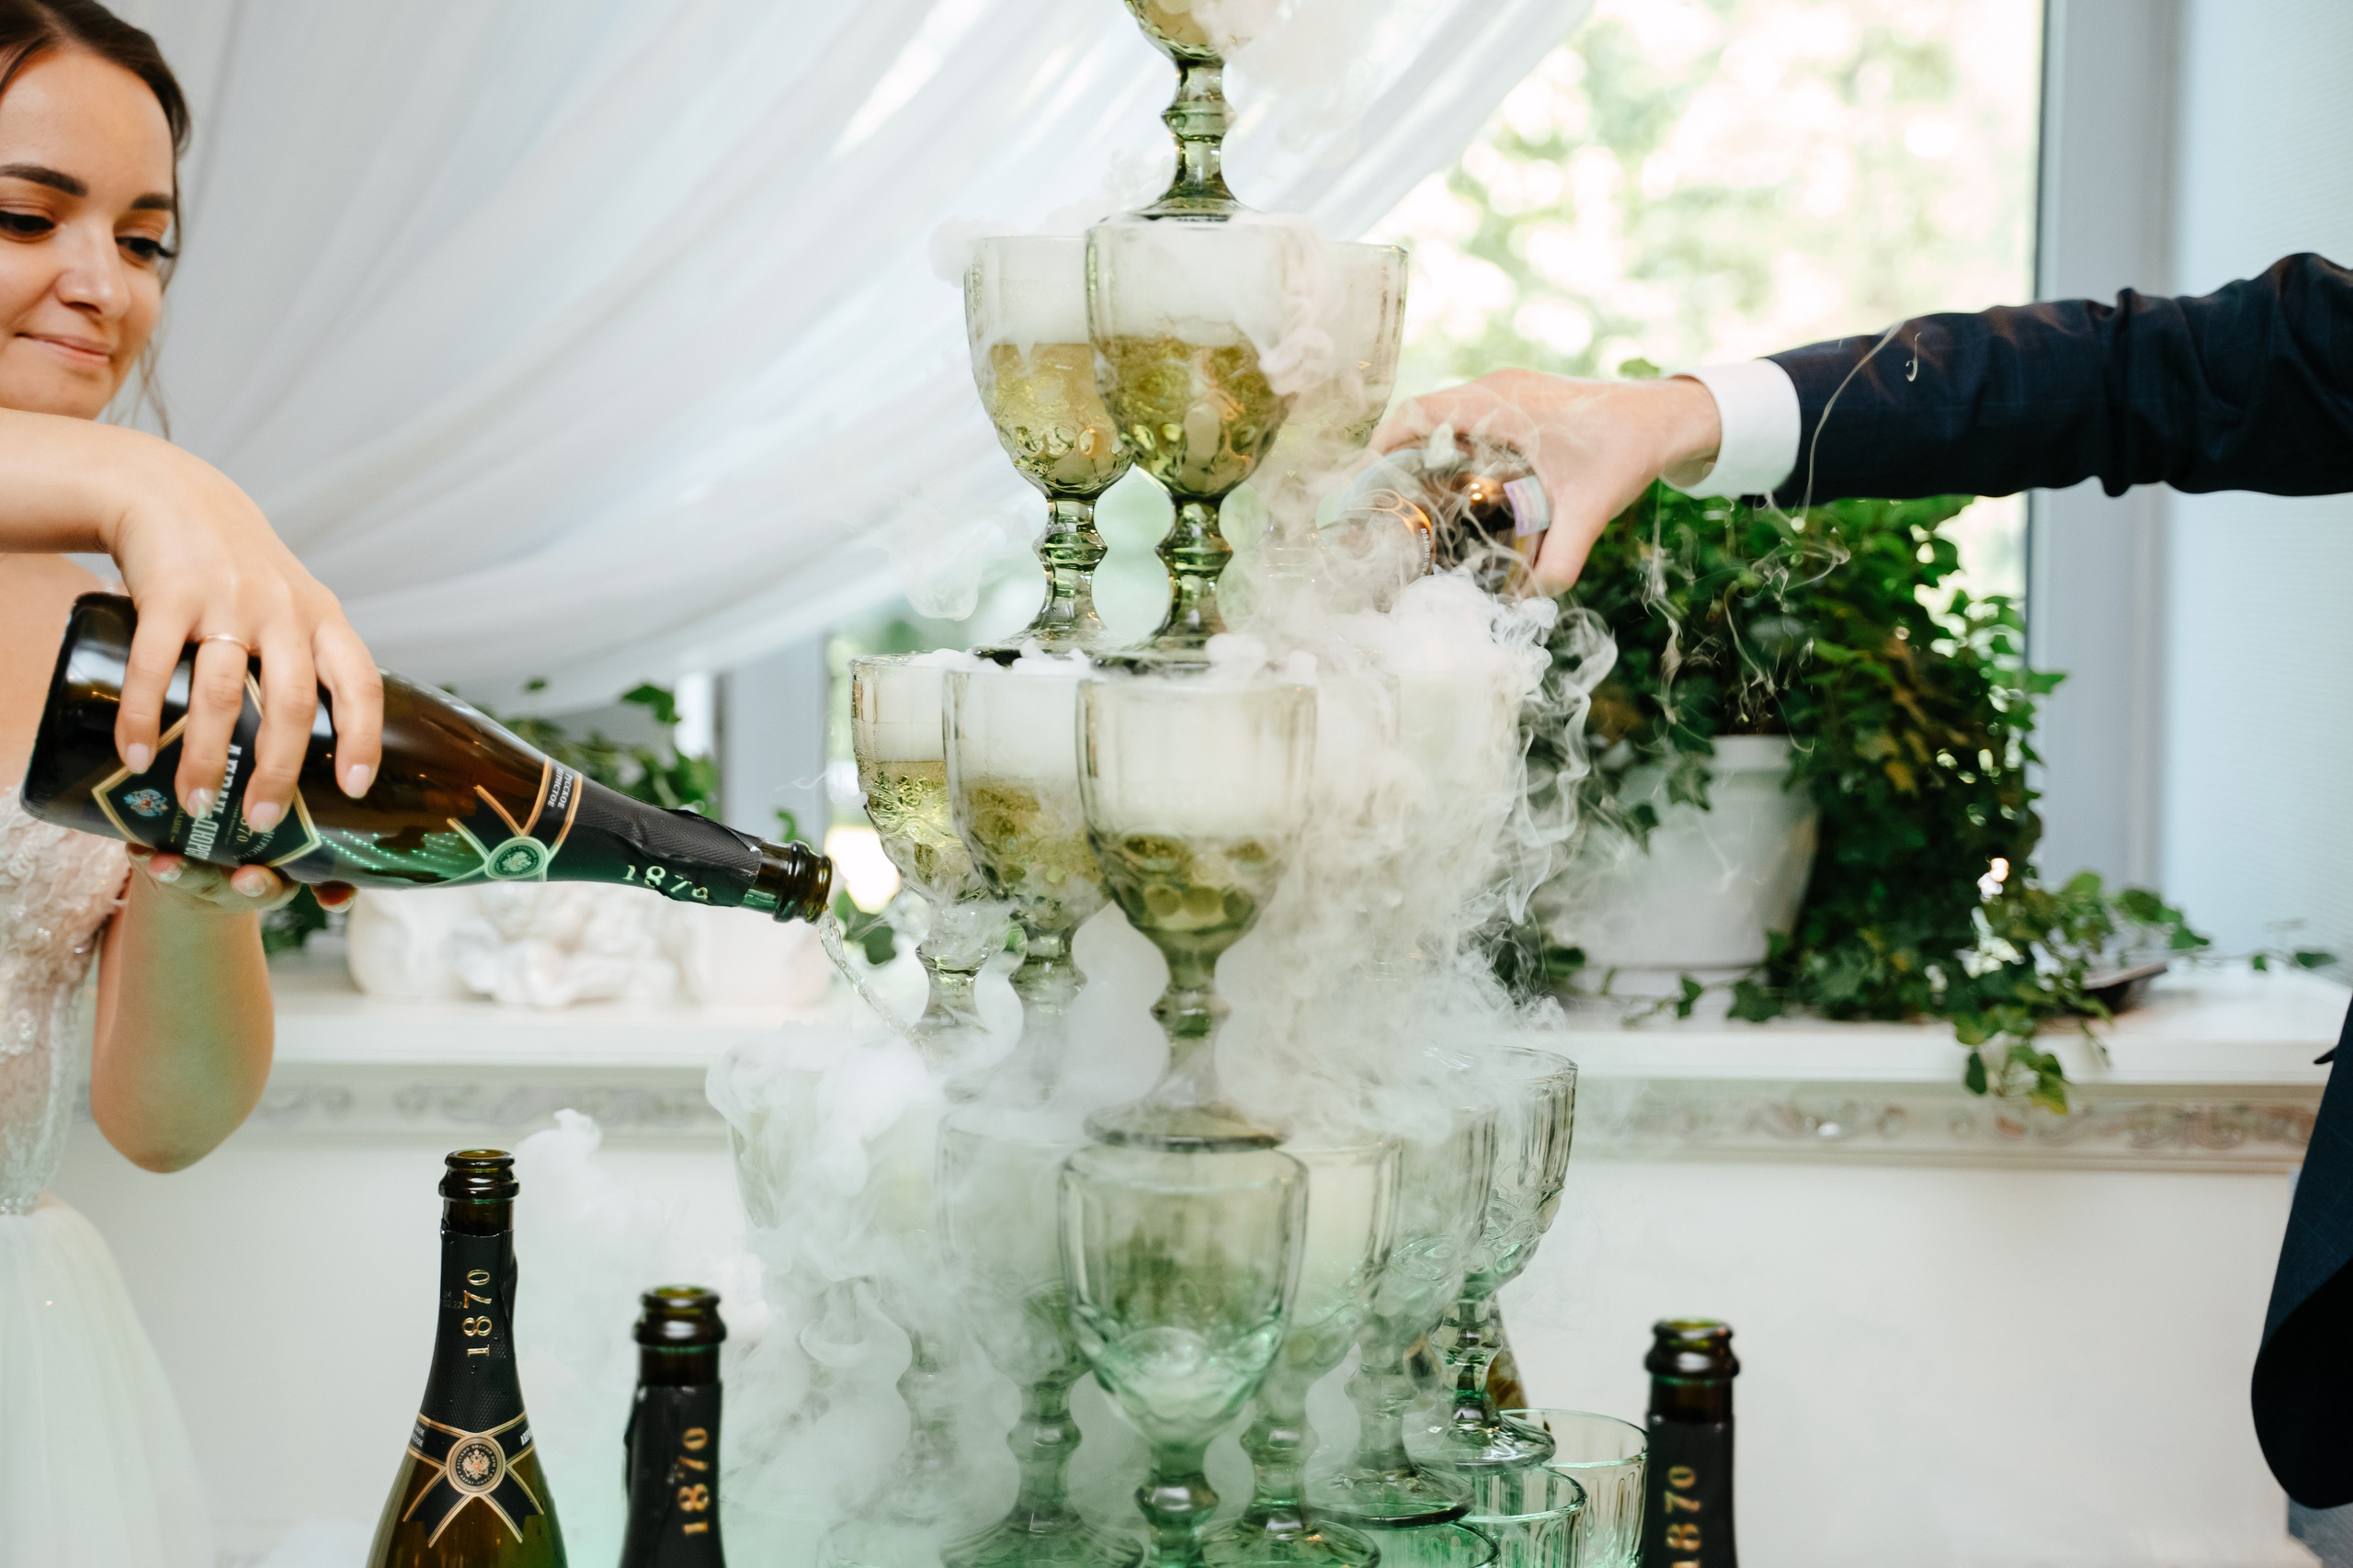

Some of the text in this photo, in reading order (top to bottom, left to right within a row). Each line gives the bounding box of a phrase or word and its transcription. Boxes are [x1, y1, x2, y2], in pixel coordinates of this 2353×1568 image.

[622, 864, 709, 900] 1870
[462, 1268, 493, 1358] 1870
[677, 1426, 710, 1536] 1870
